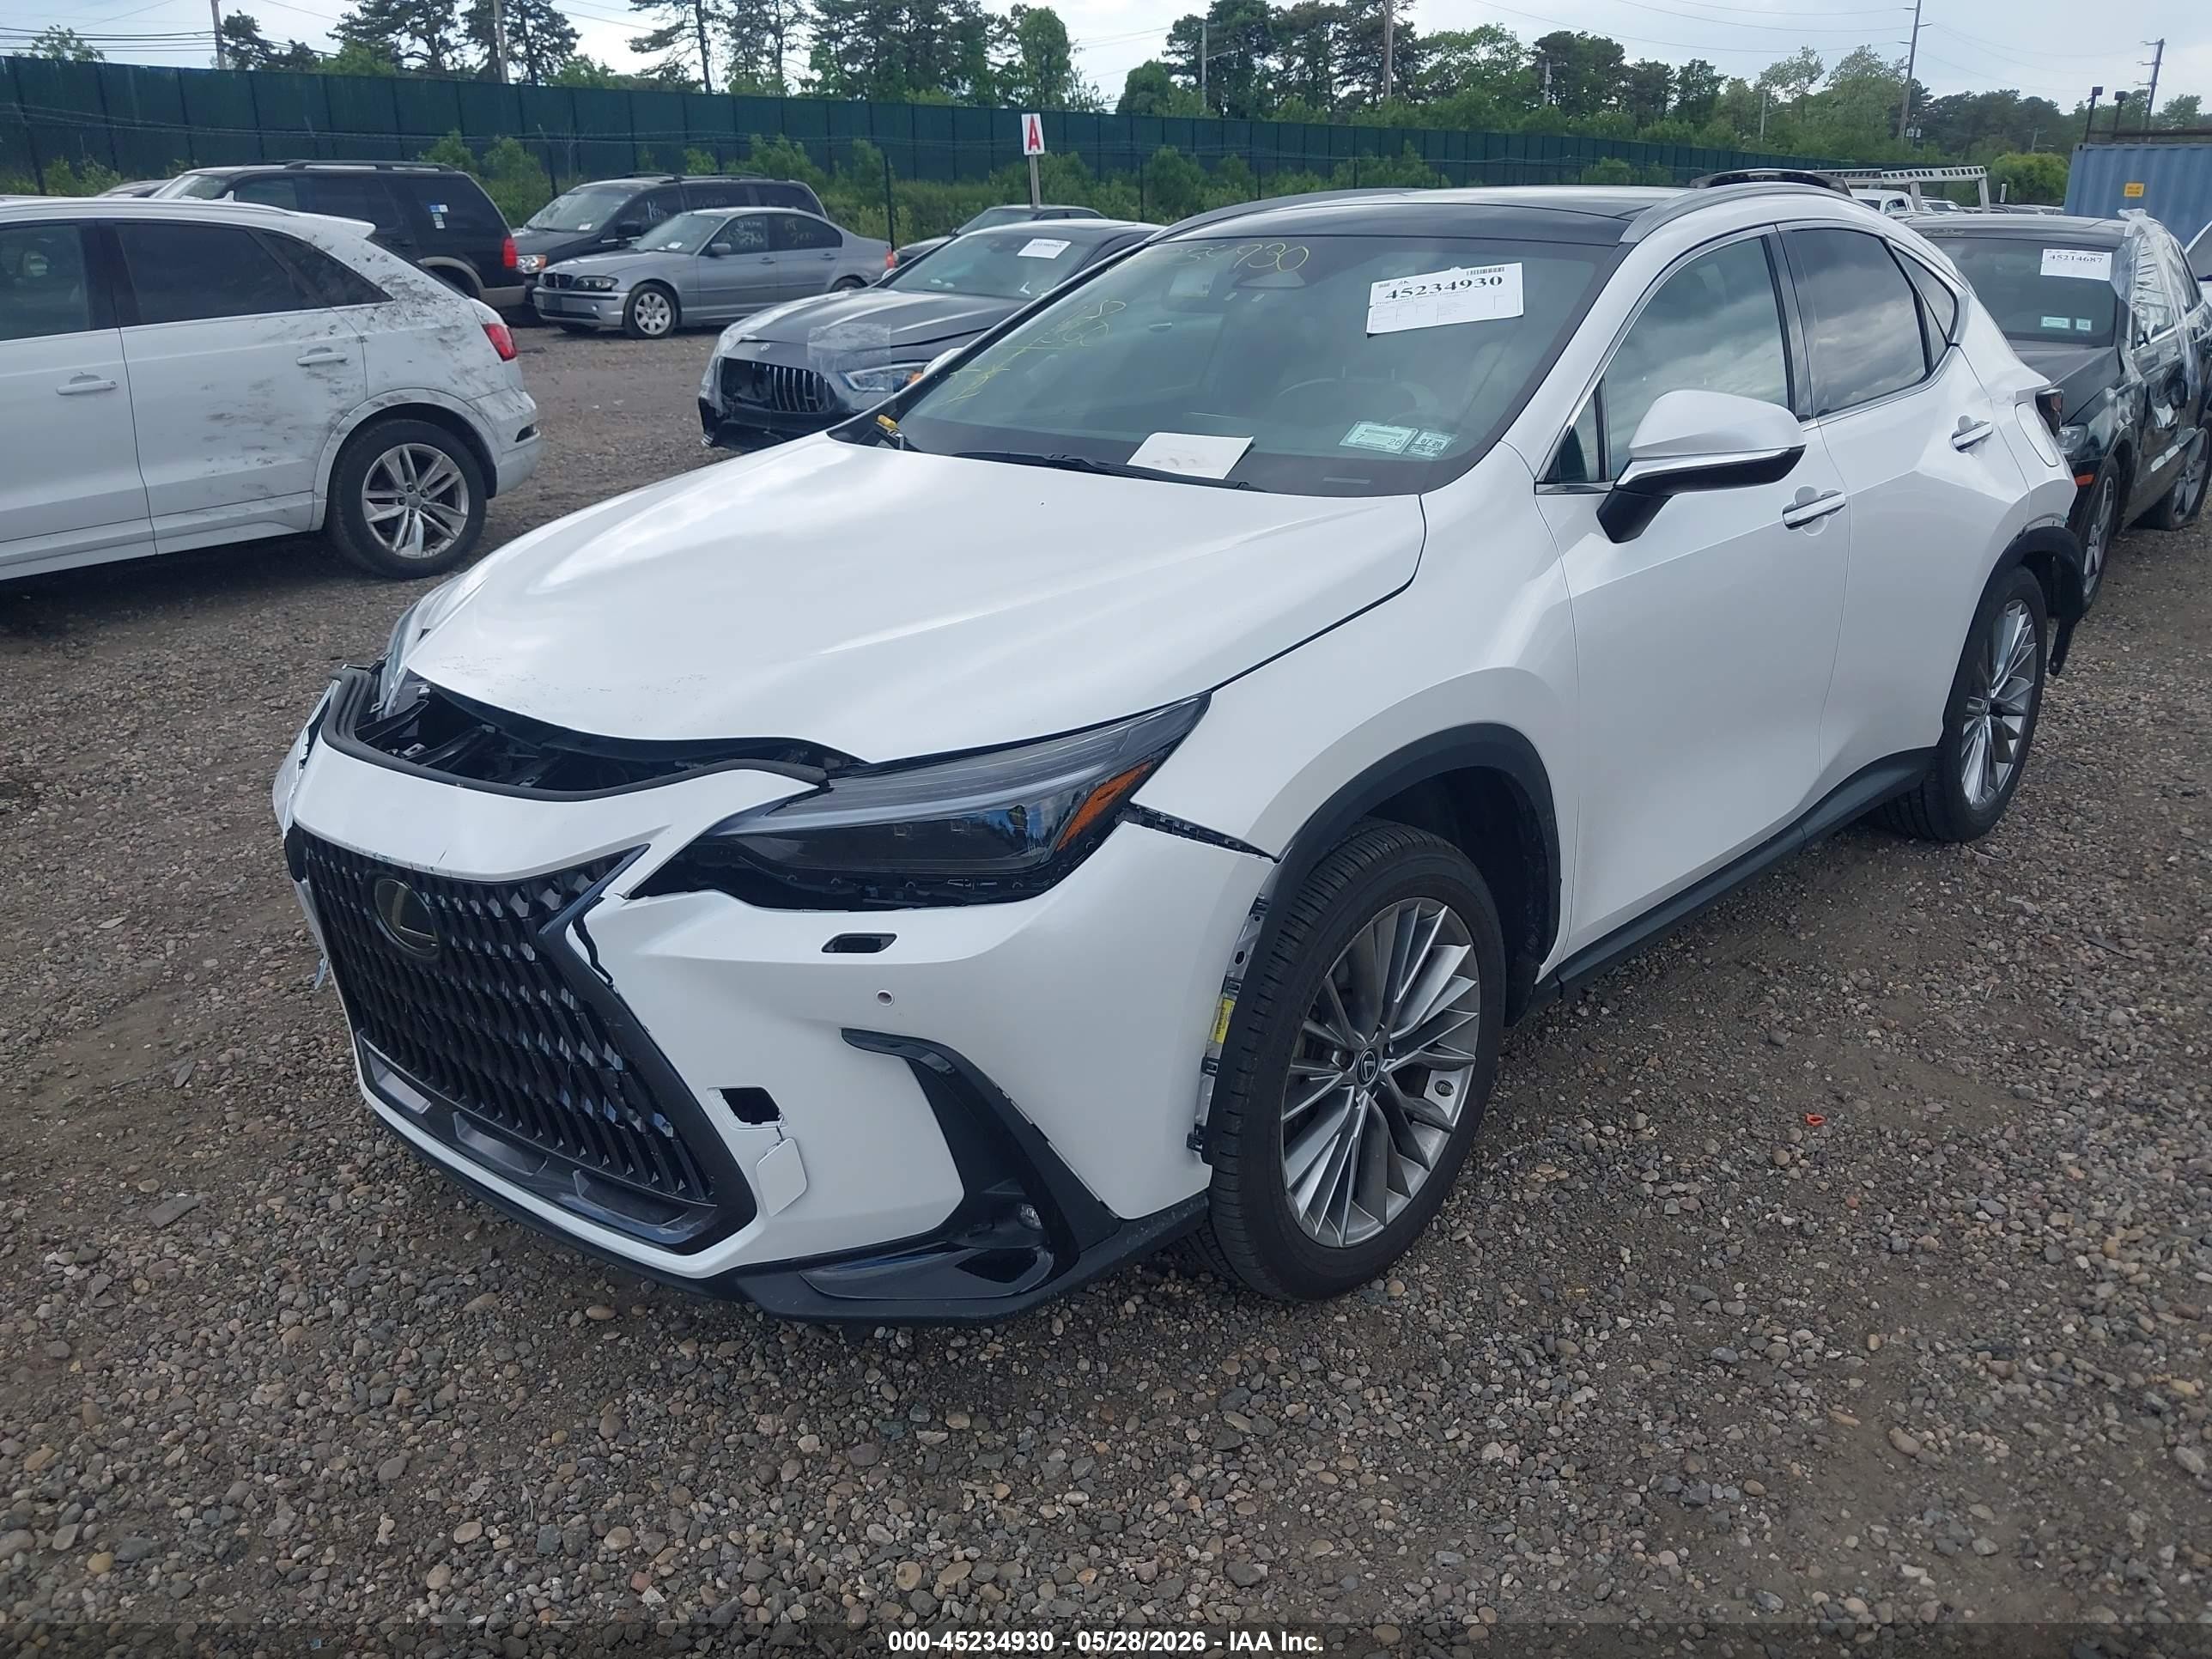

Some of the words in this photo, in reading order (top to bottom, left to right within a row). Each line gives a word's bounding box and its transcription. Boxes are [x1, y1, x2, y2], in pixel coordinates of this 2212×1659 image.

[1027, 114, 1041, 151] A
[2049, 254, 2103, 263] 45214687
[1384, 275, 1504, 300] 45234930
[1387, 438, 1403, 447] 26
